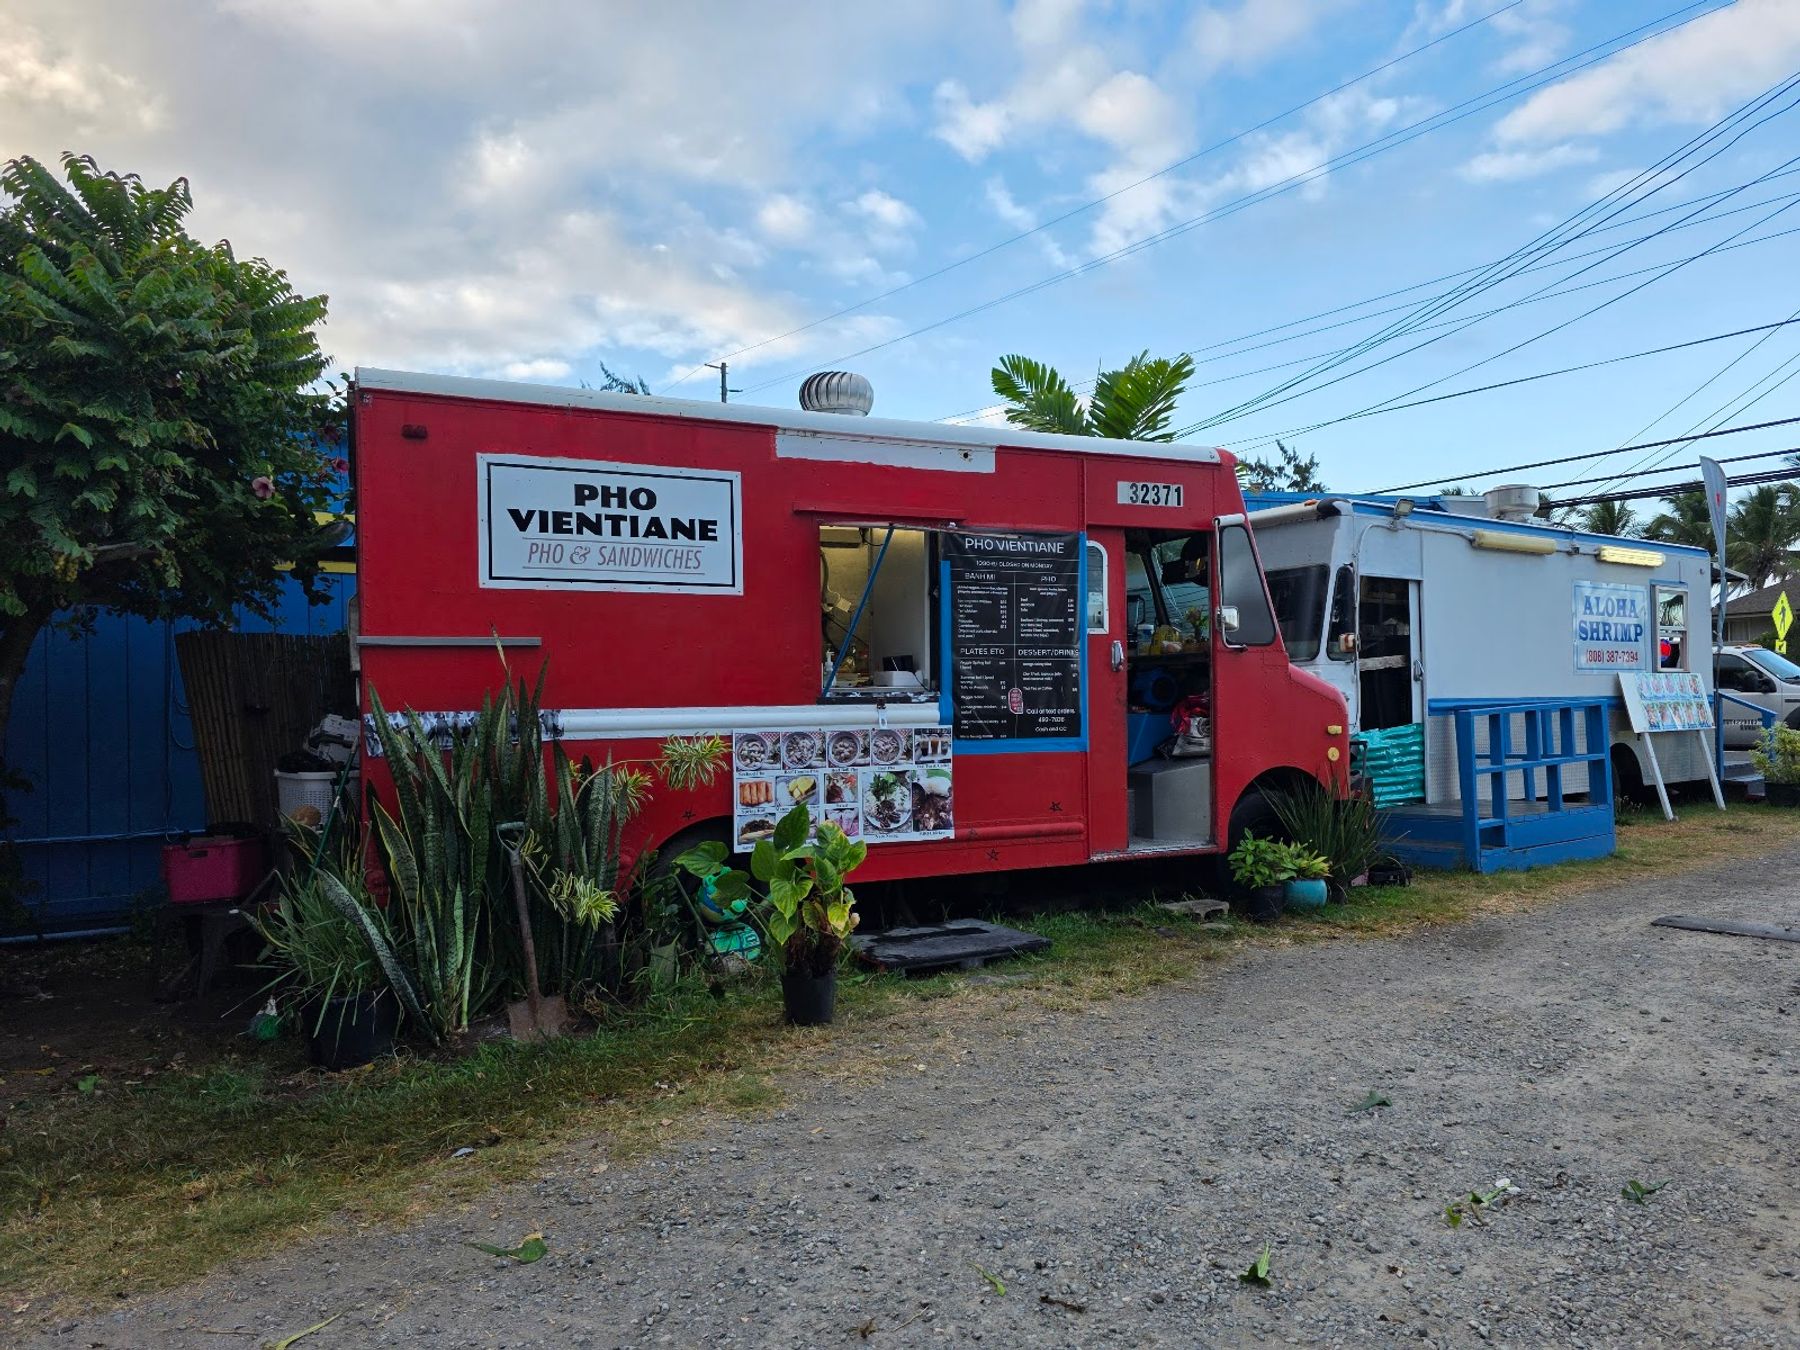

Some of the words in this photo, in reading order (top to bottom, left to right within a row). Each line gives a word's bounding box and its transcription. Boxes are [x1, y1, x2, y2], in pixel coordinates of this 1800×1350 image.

[574, 484, 656, 511] PHO
[1129, 482, 1181, 507] 32371
[507, 508, 718, 542] VIENTIANE
[528, 542, 564, 565] PHO
[569, 545, 591, 565] &
[597, 545, 702, 570] SANDWICHES
[965, 537, 994, 550] PHO
[995, 539, 1064, 554] VIENTIANE
[1583, 595, 1639, 618] ALOHA
[1579, 619, 1643, 643] SHRIMP
[989, 648, 1005, 656] ETC
[1586, 648, 1604, 664] (808)
[1605, 649, 1639, 664] 387-7394
